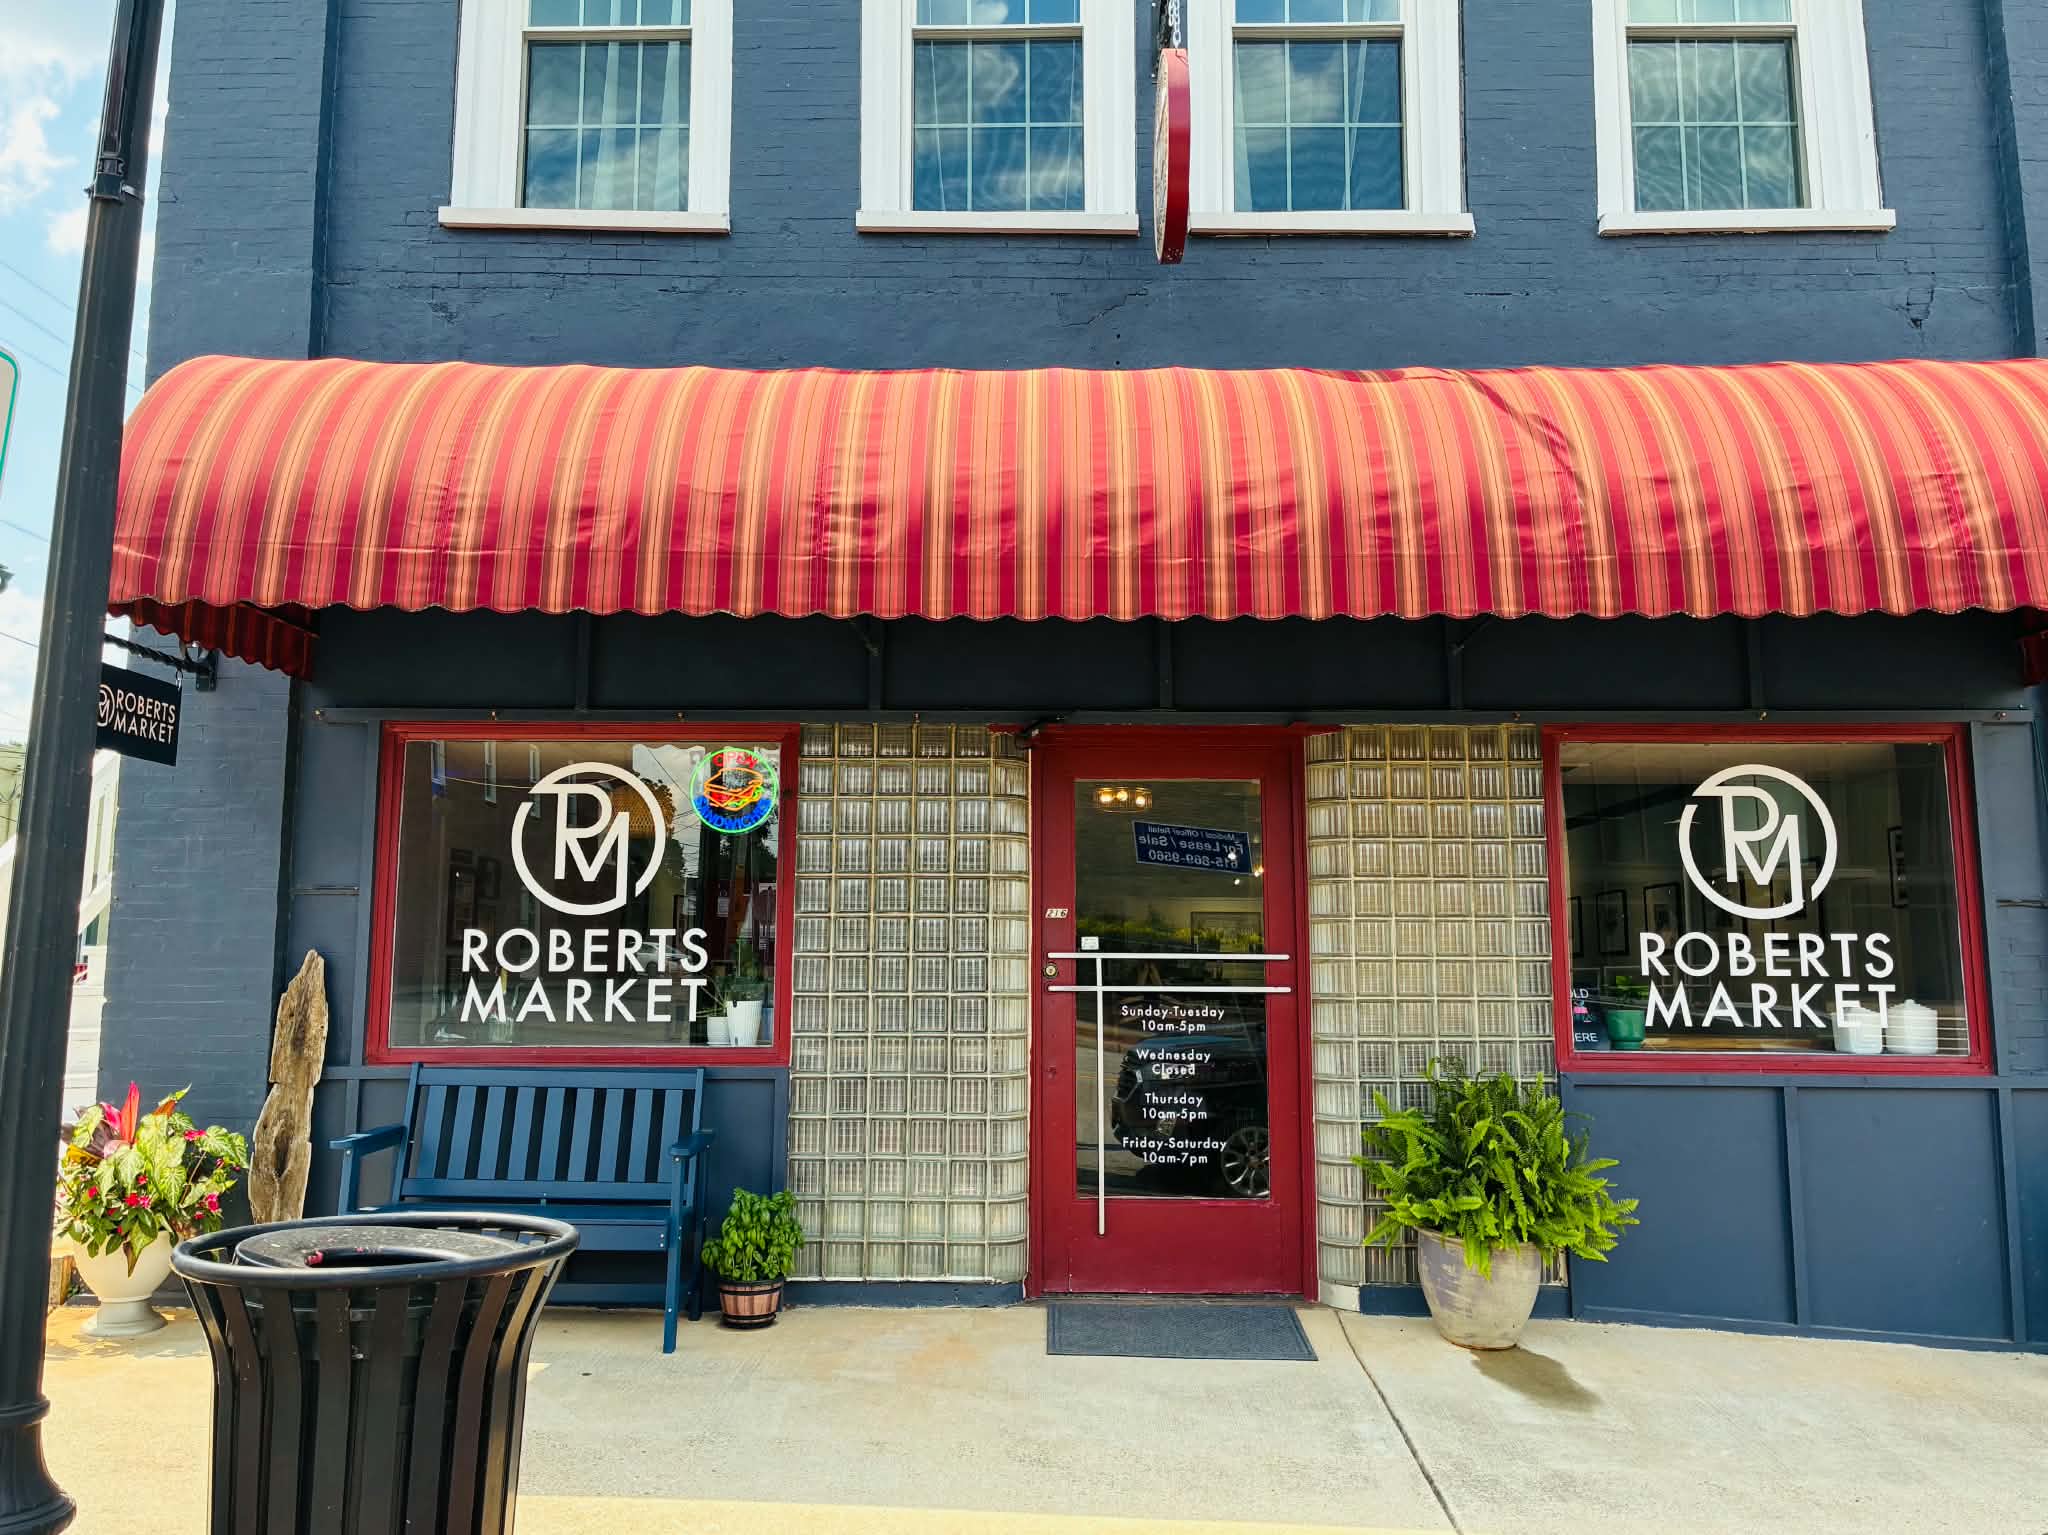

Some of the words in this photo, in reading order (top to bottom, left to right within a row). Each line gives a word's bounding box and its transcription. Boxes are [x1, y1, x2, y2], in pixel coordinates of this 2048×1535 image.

[116, 688, 176, 724] ROBERTS
[113, 711, 174, 744] MARKET
[712, 750, 758, 769] OPEN
[461, 927, 709, 973] ROBERTS
[1639, 931, 1895, 979] ROBERTS
[460, 976, 708, 1022] MARKET
[1644, 981, 1897, 1029] MARKET
[1121, 1005, 1225, 1020] Sunday-Tuesday
[1141, 1020, 1206, 1034] 10am-5pm
[1573, 1032, 1599, 1042] ERE
[1136, 1048, 1211, 1063] Wednesday
[1152, 1063, 1196, 1076] Closed
[1145, 1092, 1204, 1107] Thursday
[1142, 1107, 1207, 1121] 10am-5pm
[1122, 1137, 1227, 1152] Friday-Saturday
[1142, 1152, 1208, 1166] 10am-7pm
